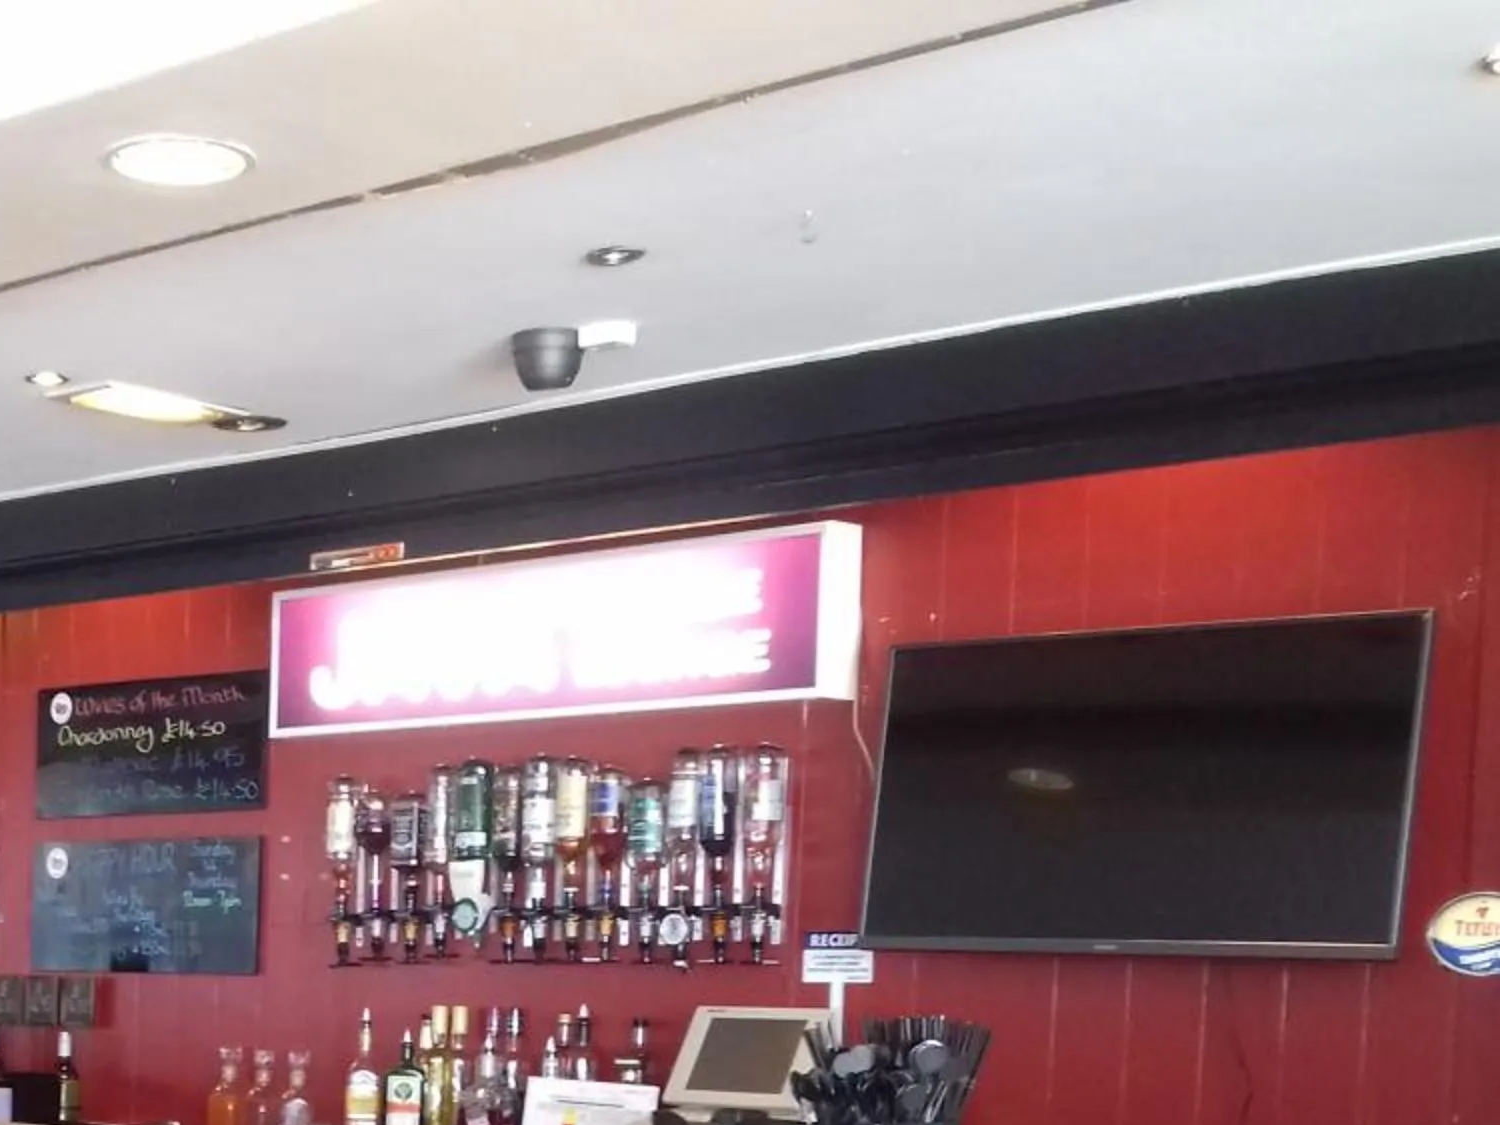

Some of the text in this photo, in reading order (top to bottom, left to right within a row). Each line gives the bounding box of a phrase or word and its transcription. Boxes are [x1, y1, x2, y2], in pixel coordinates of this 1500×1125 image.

[130, 689, 147, 713] of
[152, 690, 176, 710] the
[181, 685, 245, 708] Month
